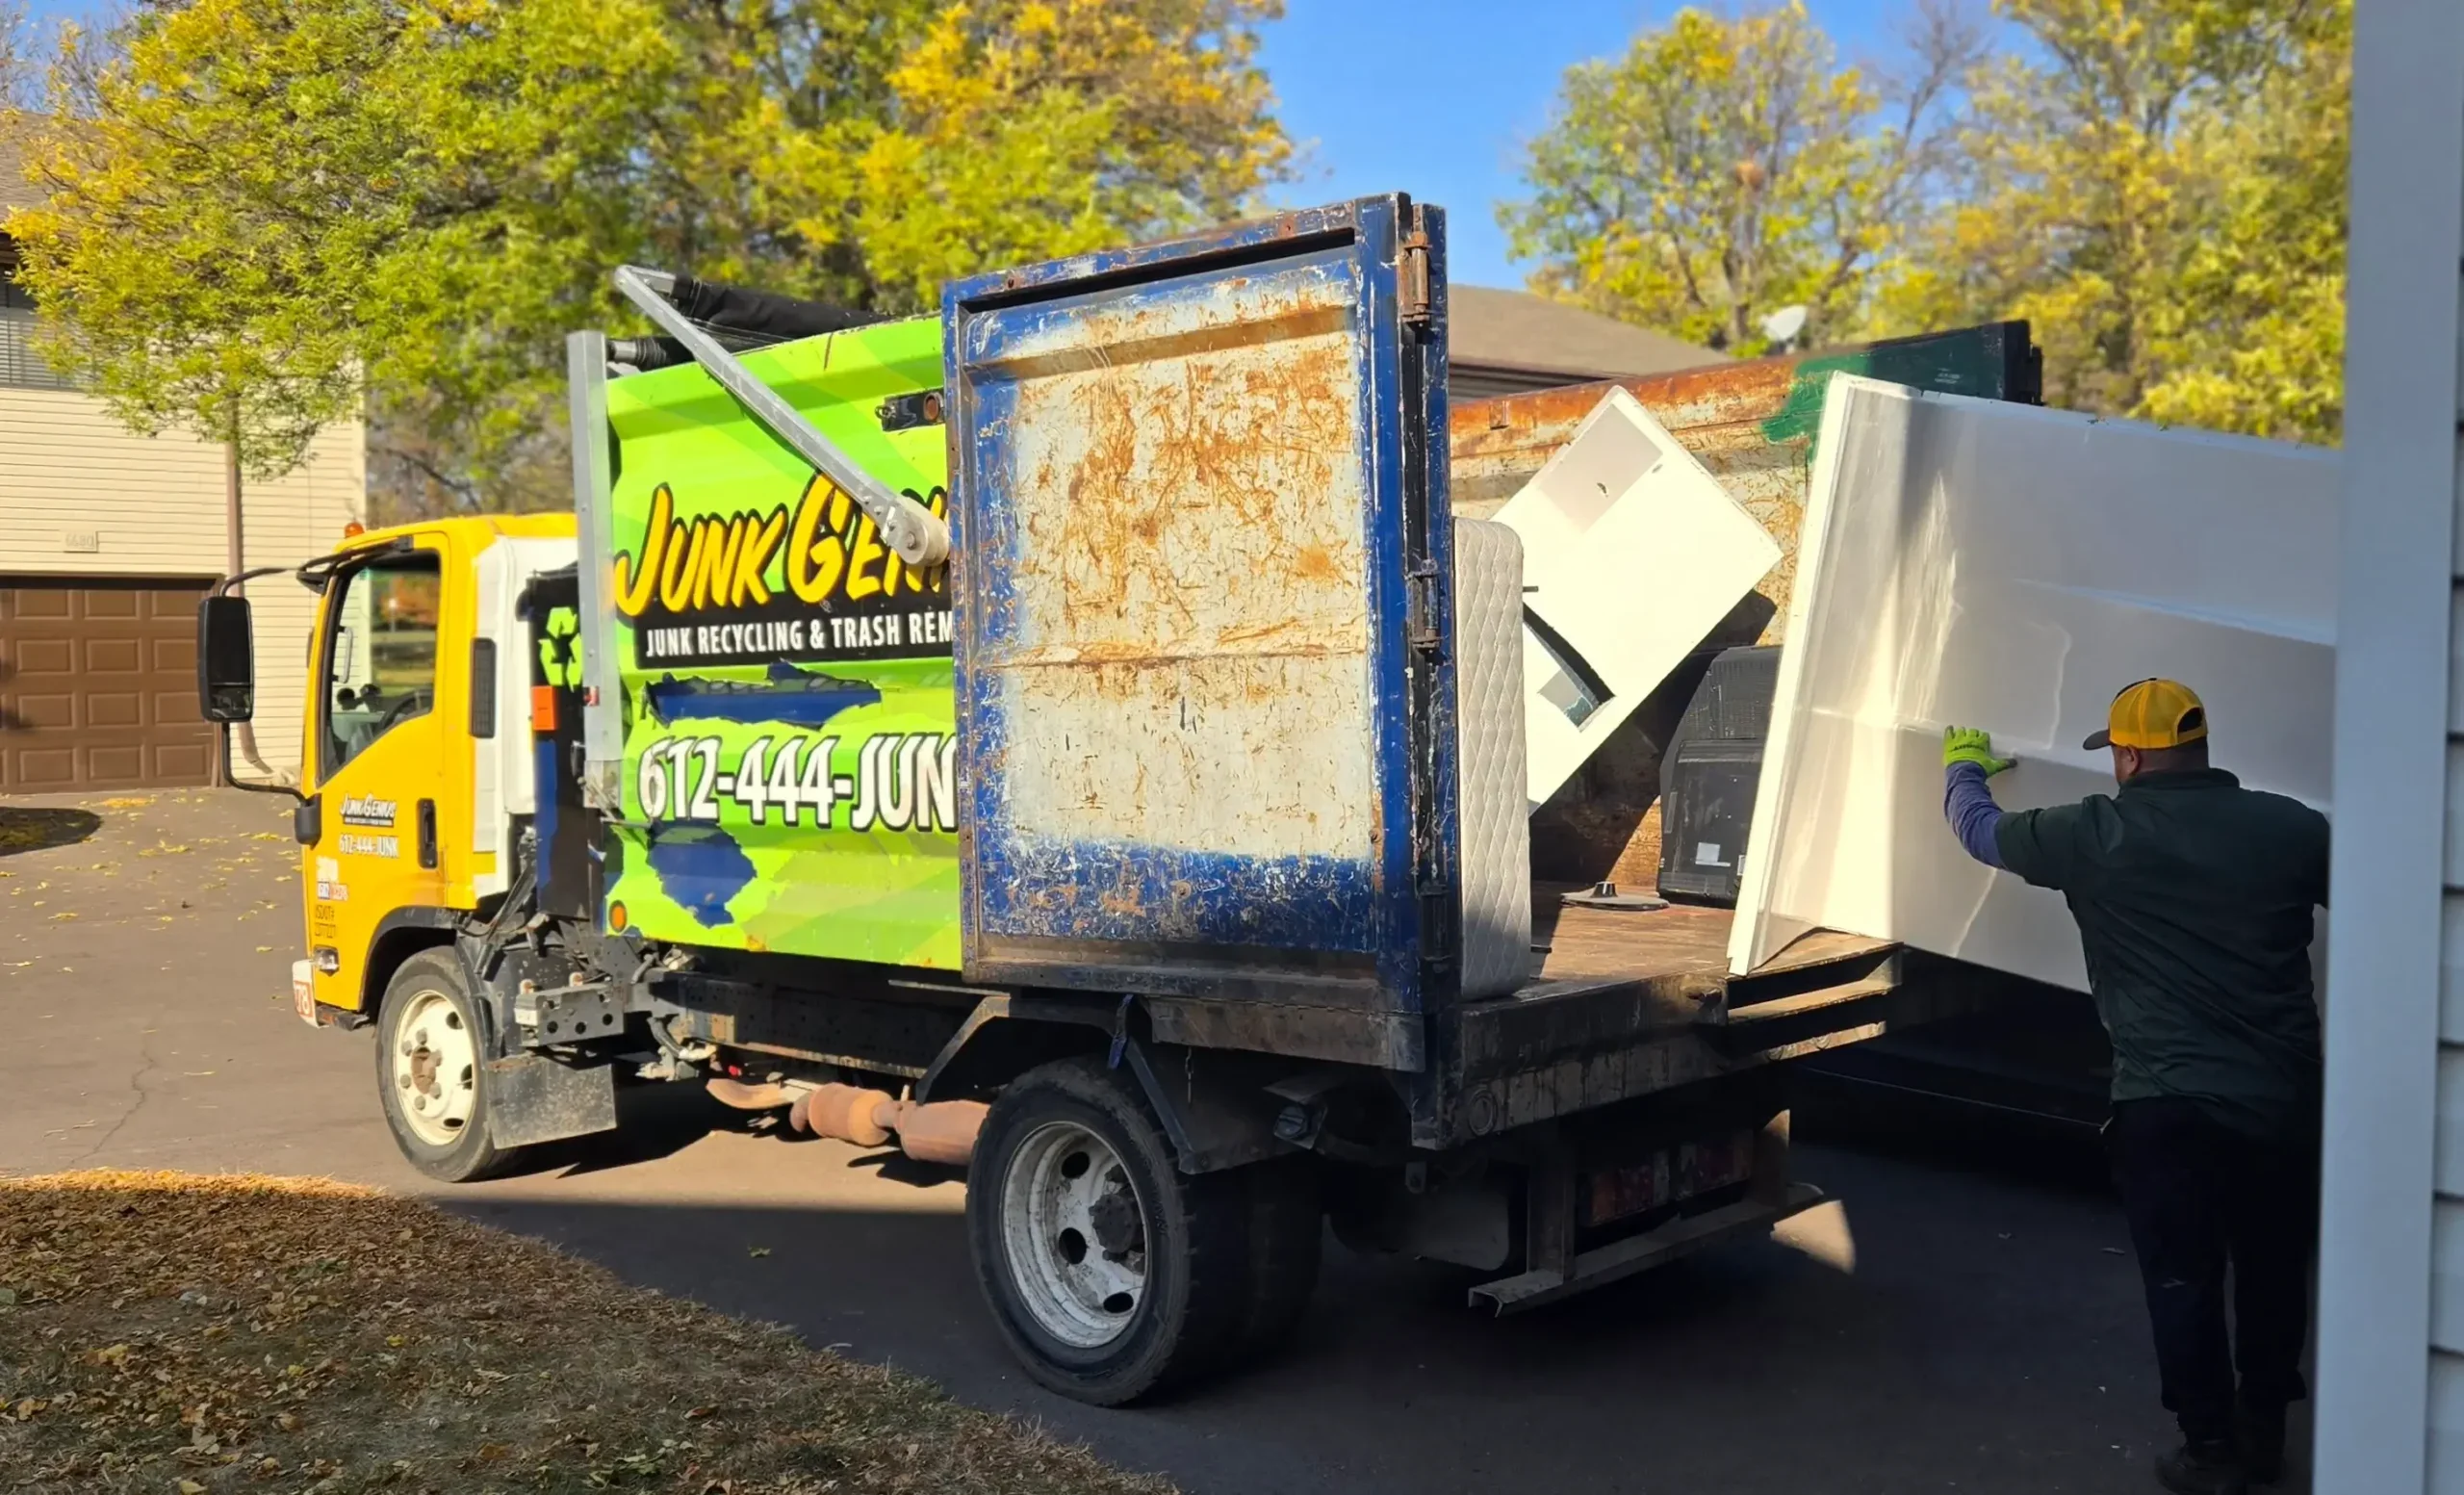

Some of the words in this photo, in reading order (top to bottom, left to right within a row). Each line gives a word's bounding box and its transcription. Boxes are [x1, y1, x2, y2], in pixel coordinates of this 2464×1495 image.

[614, 484, 786, 617] JUNK
[646, 628, 693, 657] JUNK
[698, 620, 803, 656] RECYCLING
[809, 618, 826, 650] &
[831, 613, 900, 649] TRASH
